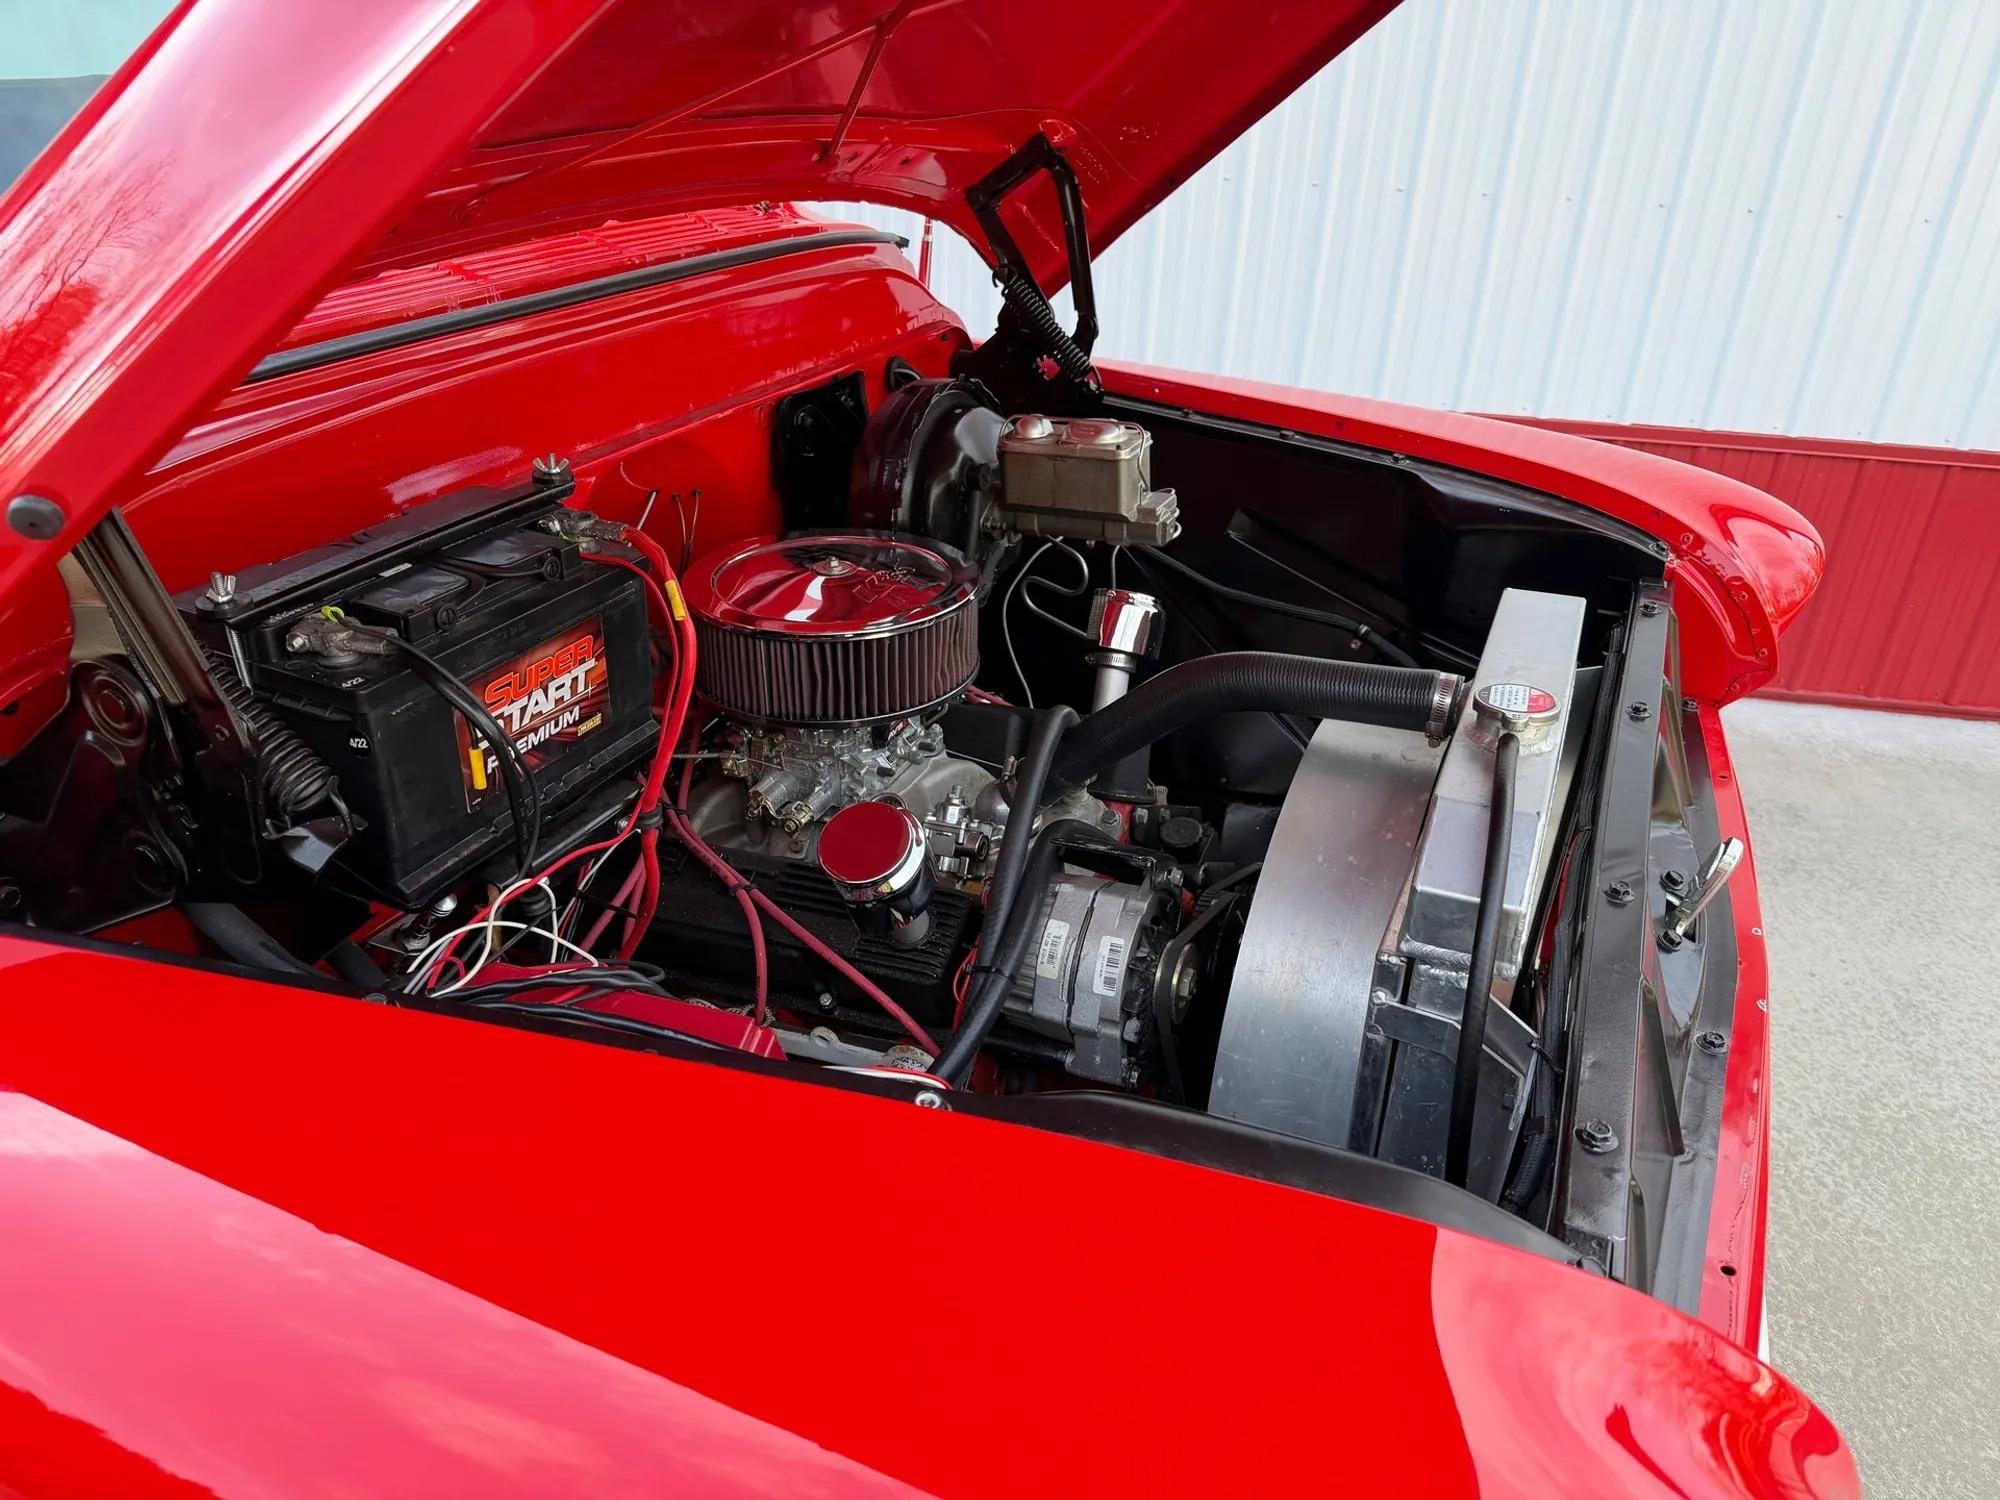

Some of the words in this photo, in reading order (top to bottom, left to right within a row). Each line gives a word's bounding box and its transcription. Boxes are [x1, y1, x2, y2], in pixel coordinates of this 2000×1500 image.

[341, 676, 366, 688] 4/22
[485, 635, 594, 711] SUPER
[349, 737, 369, 749] 4/22
[486, 705, 580, 774] PEMIUM
